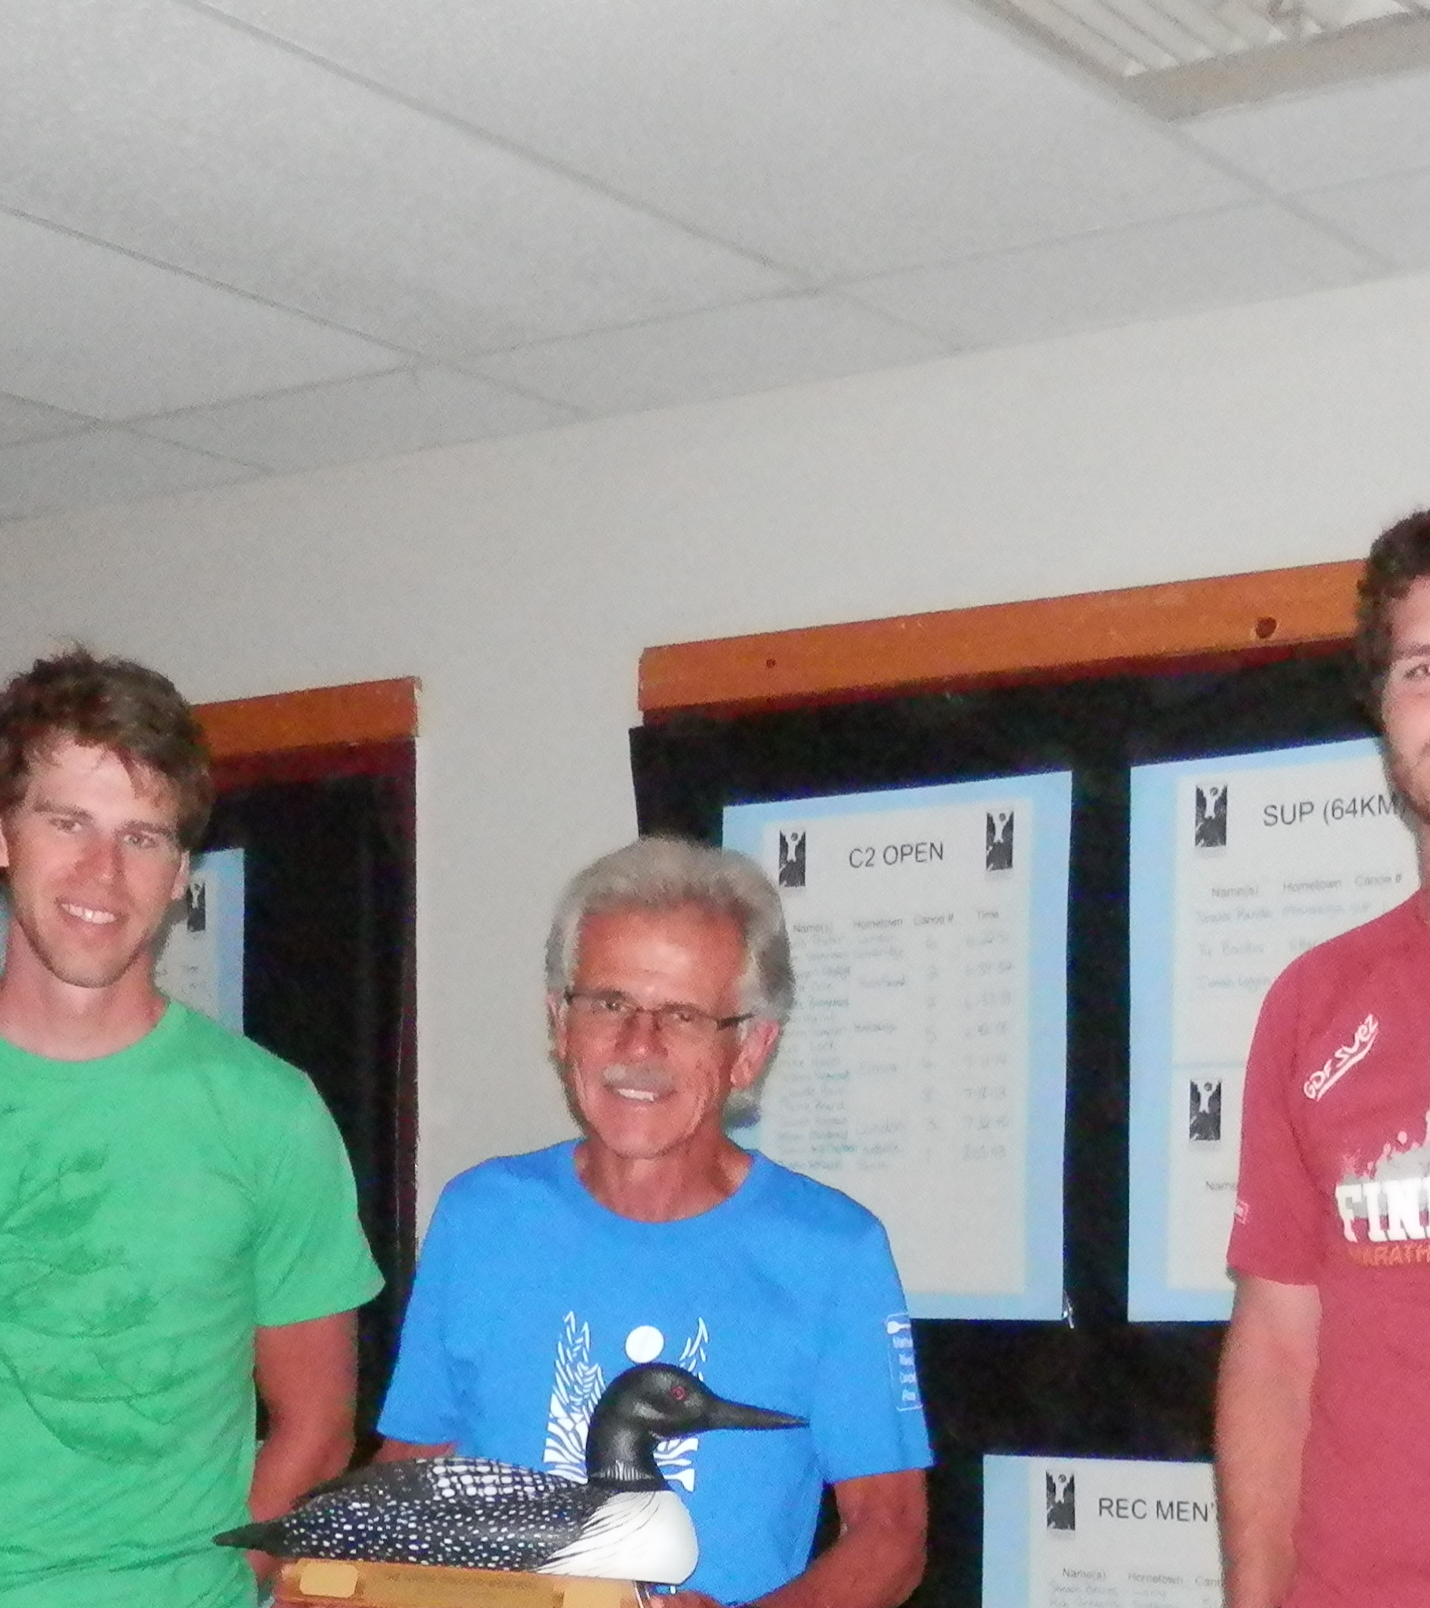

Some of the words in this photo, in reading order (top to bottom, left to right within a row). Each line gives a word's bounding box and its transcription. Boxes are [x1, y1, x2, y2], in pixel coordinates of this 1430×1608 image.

[1263, 801, 1314, 827] SUP
[1323, 794, 1407, 826] (64KM
[849, 848, 876, 869] C2
[883, 842, 945, 866] OPEN
[1099, 1497, 1148, 1520] REC
[1156, 1499, 1214, 1522] MEN'
